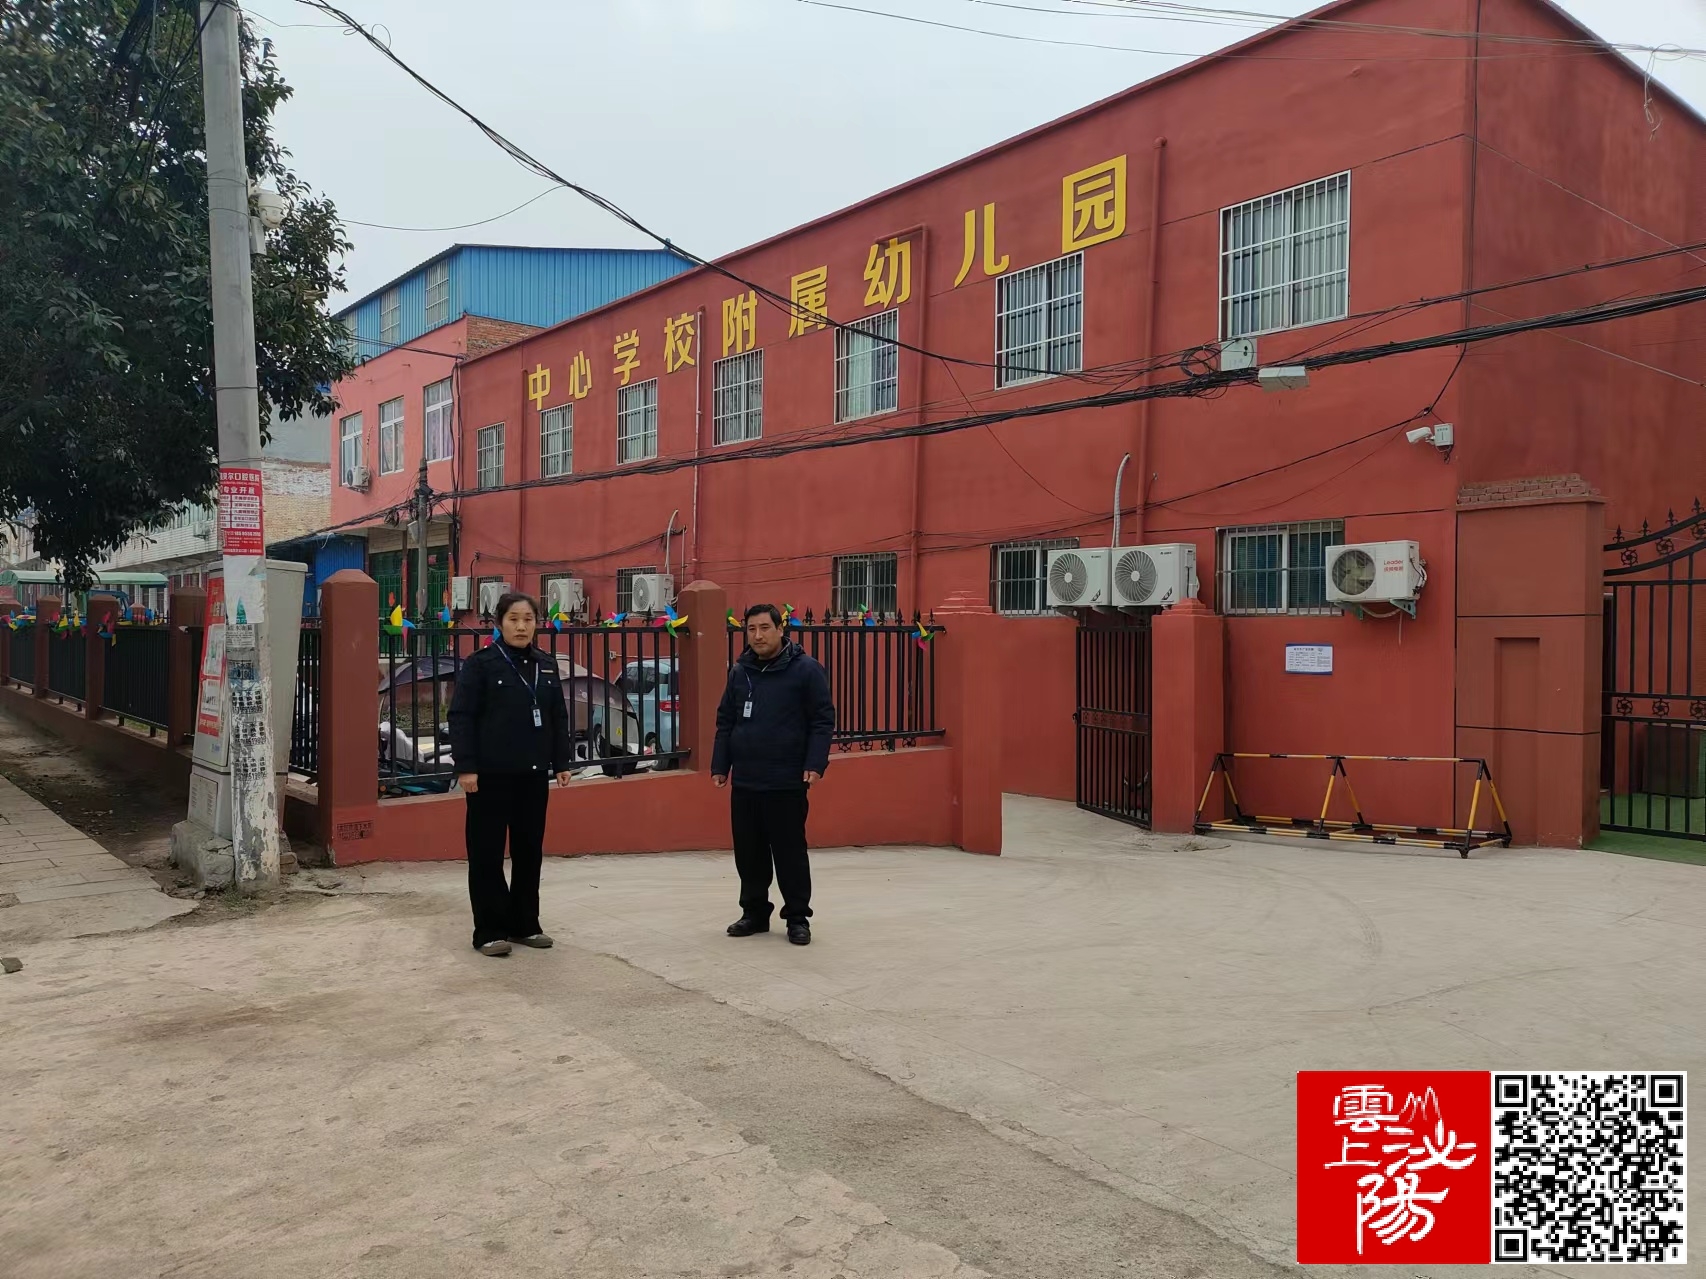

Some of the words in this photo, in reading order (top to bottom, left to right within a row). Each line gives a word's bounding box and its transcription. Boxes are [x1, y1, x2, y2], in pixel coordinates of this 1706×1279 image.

[528, 154, 1127, 410] 中心学校附属幼儿园
